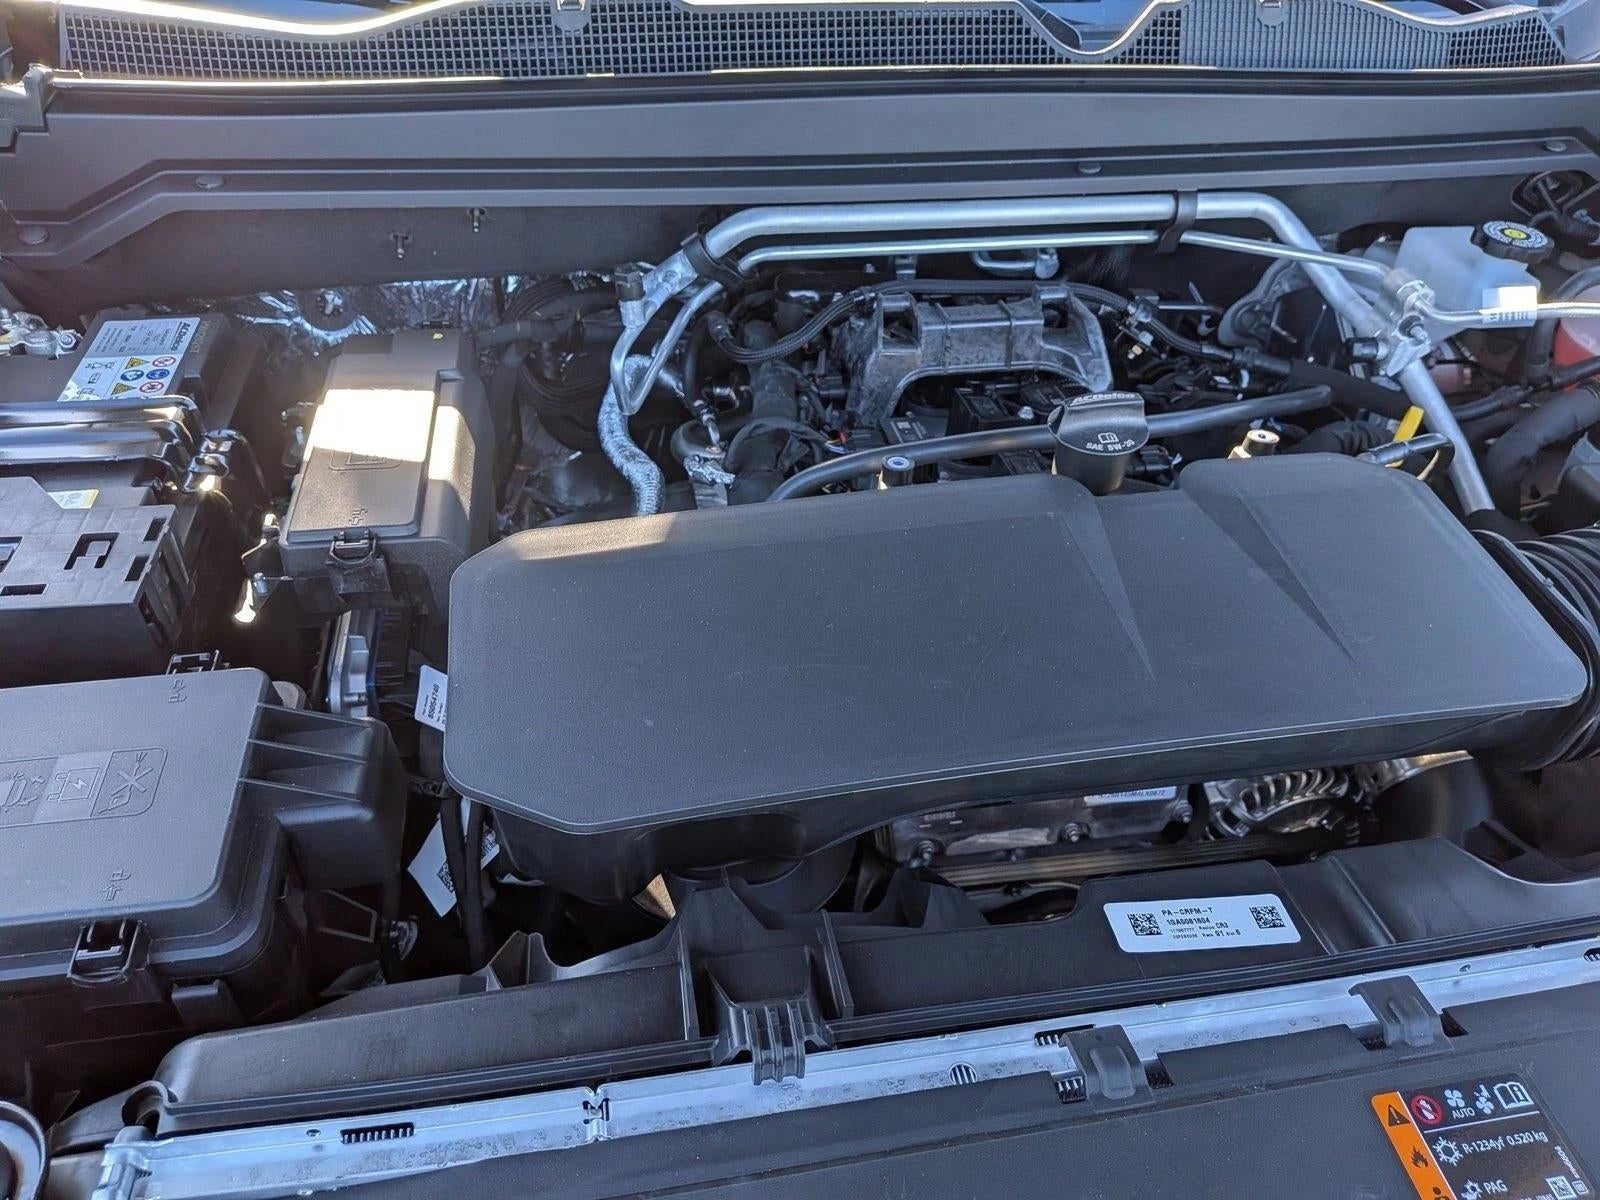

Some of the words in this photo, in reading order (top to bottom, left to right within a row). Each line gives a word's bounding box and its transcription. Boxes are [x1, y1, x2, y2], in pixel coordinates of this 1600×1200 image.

[170, 322, 191, 351] ACDelco
[1069, 393, 1136, 407] ACDelco
[1085, 442, 1104, 451] SAE
[1161, 907, 1213, 916] PA-CRFM-T
[1452, 1107, 1475, 1119] AUTO
[1462, 1137, 1504, 1154] R-1234yf
[1507, 1133, 1533, 1146] 0.520
[1534, 1131, 1548, 1143] kg
[1484, 1180, 1508, 1193] PAG
